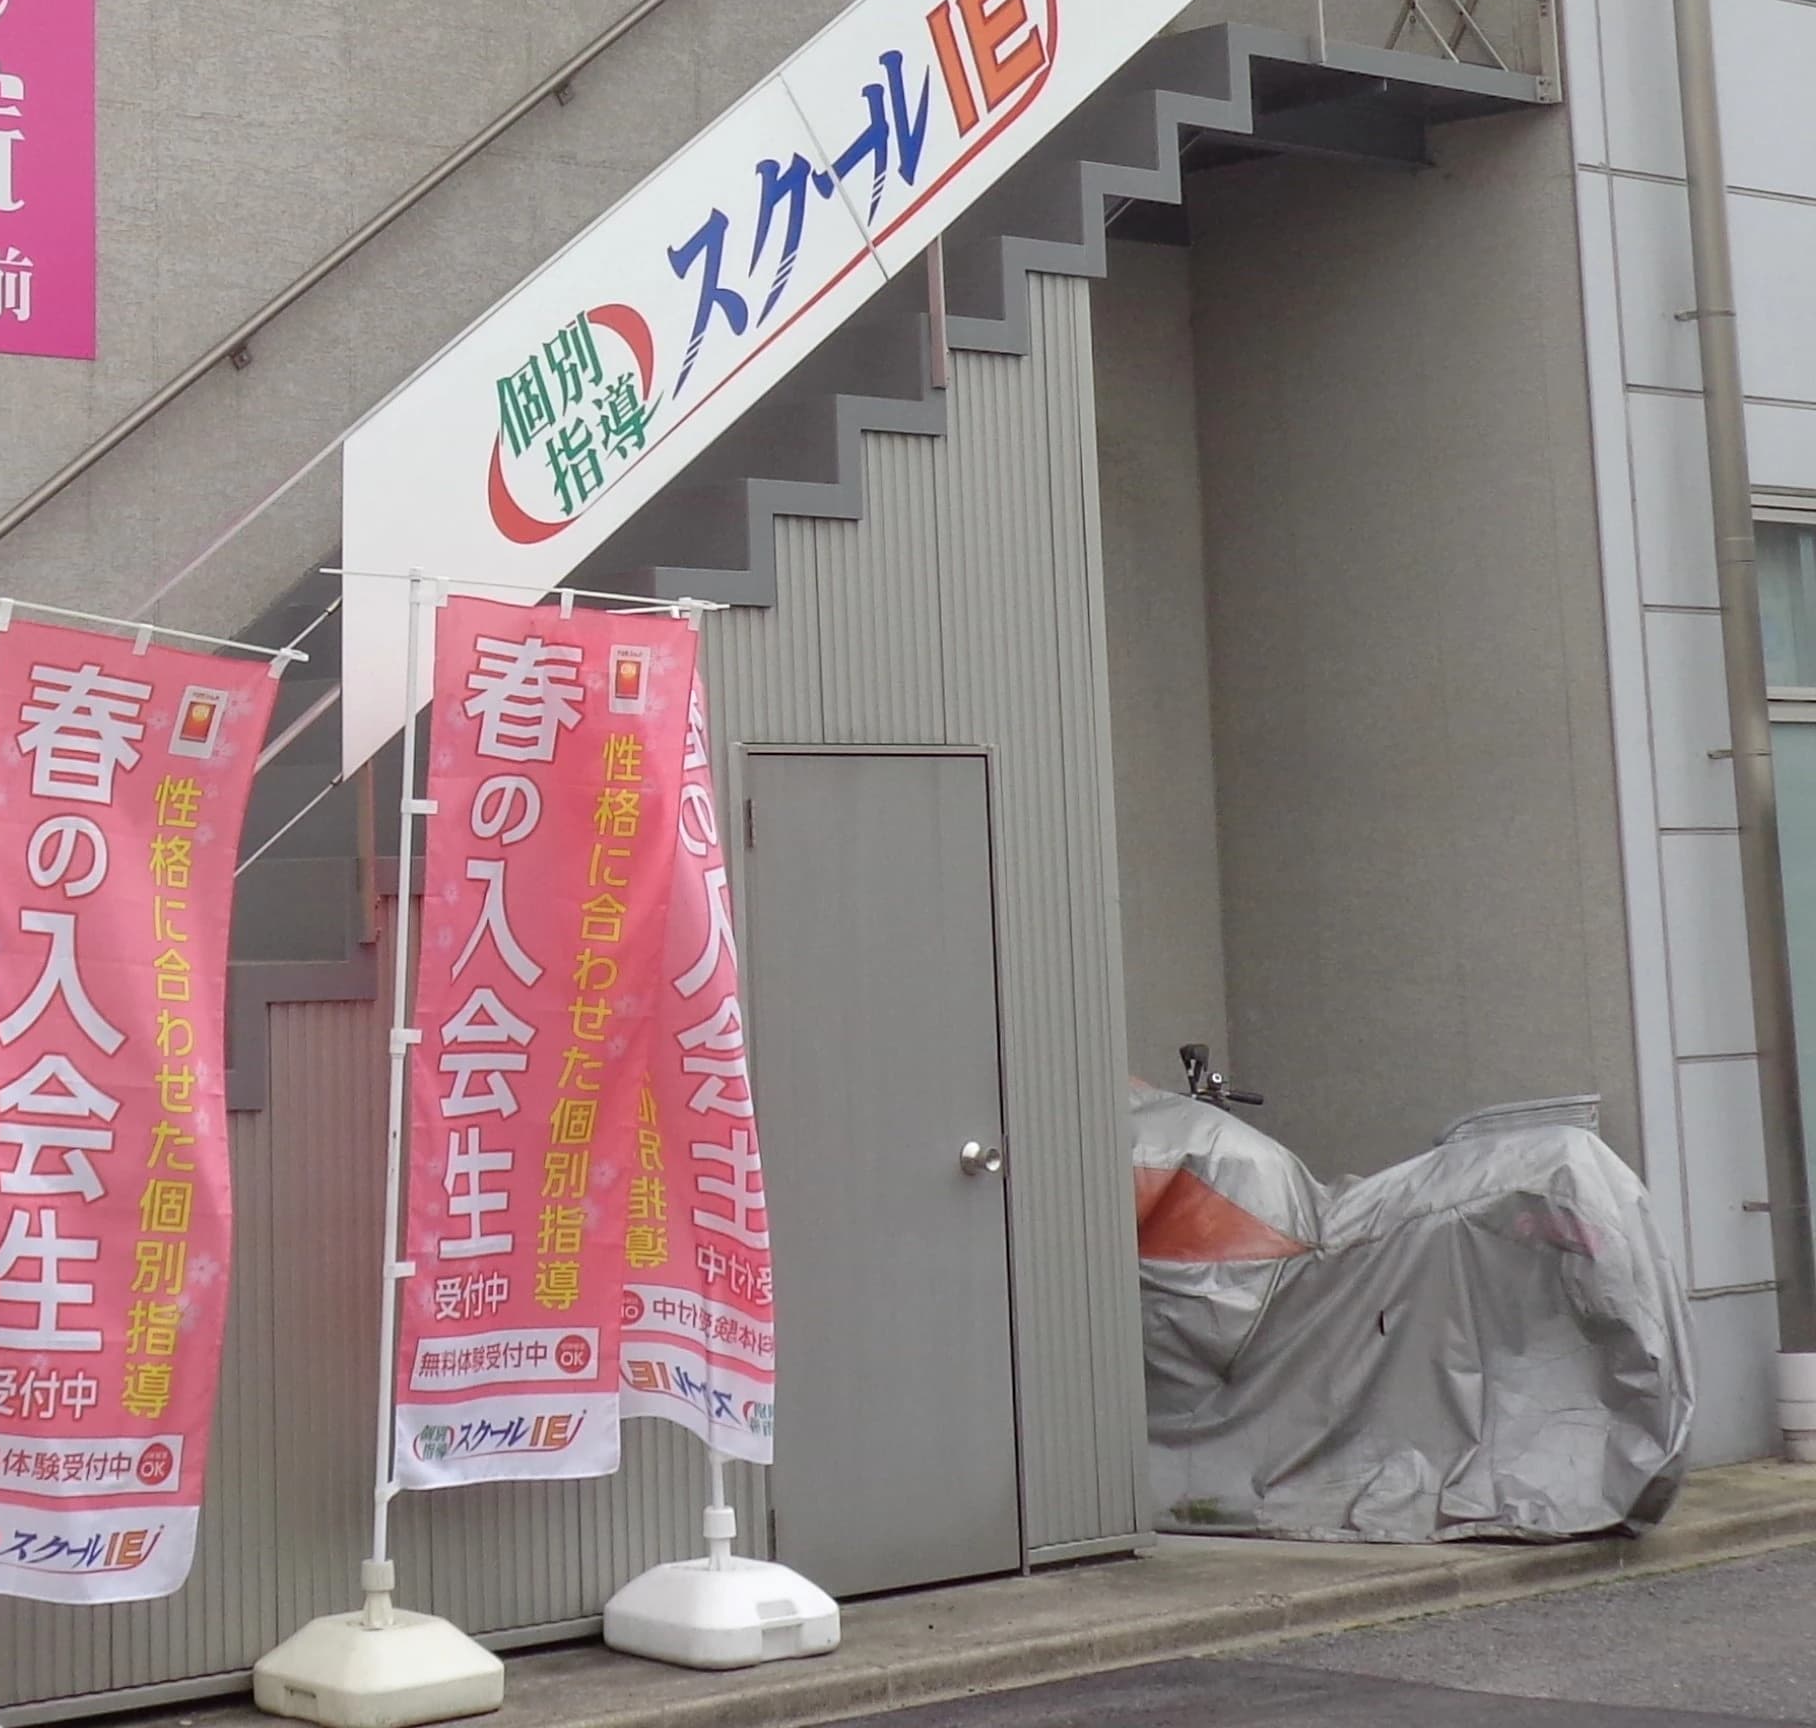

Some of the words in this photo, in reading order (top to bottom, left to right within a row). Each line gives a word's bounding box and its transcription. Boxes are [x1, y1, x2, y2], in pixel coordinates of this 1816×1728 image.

[496, 311, 605, 457] 個別
[543, 377, 665, 516] 指導
[439, 634, 584, 1261] 春の入会生
[534, 732, 645, 1311] 性格に合わせた個別指導
[120, 774, 202, 1419] 性格に合わせた個別指導
[419, 1340, 548, 1377] 無料体験受付中
[434, 1272, 510, 1321] 受付中
[560, 1351, 584, 1366] OK
[141, 1462, 165, 1478] OK
